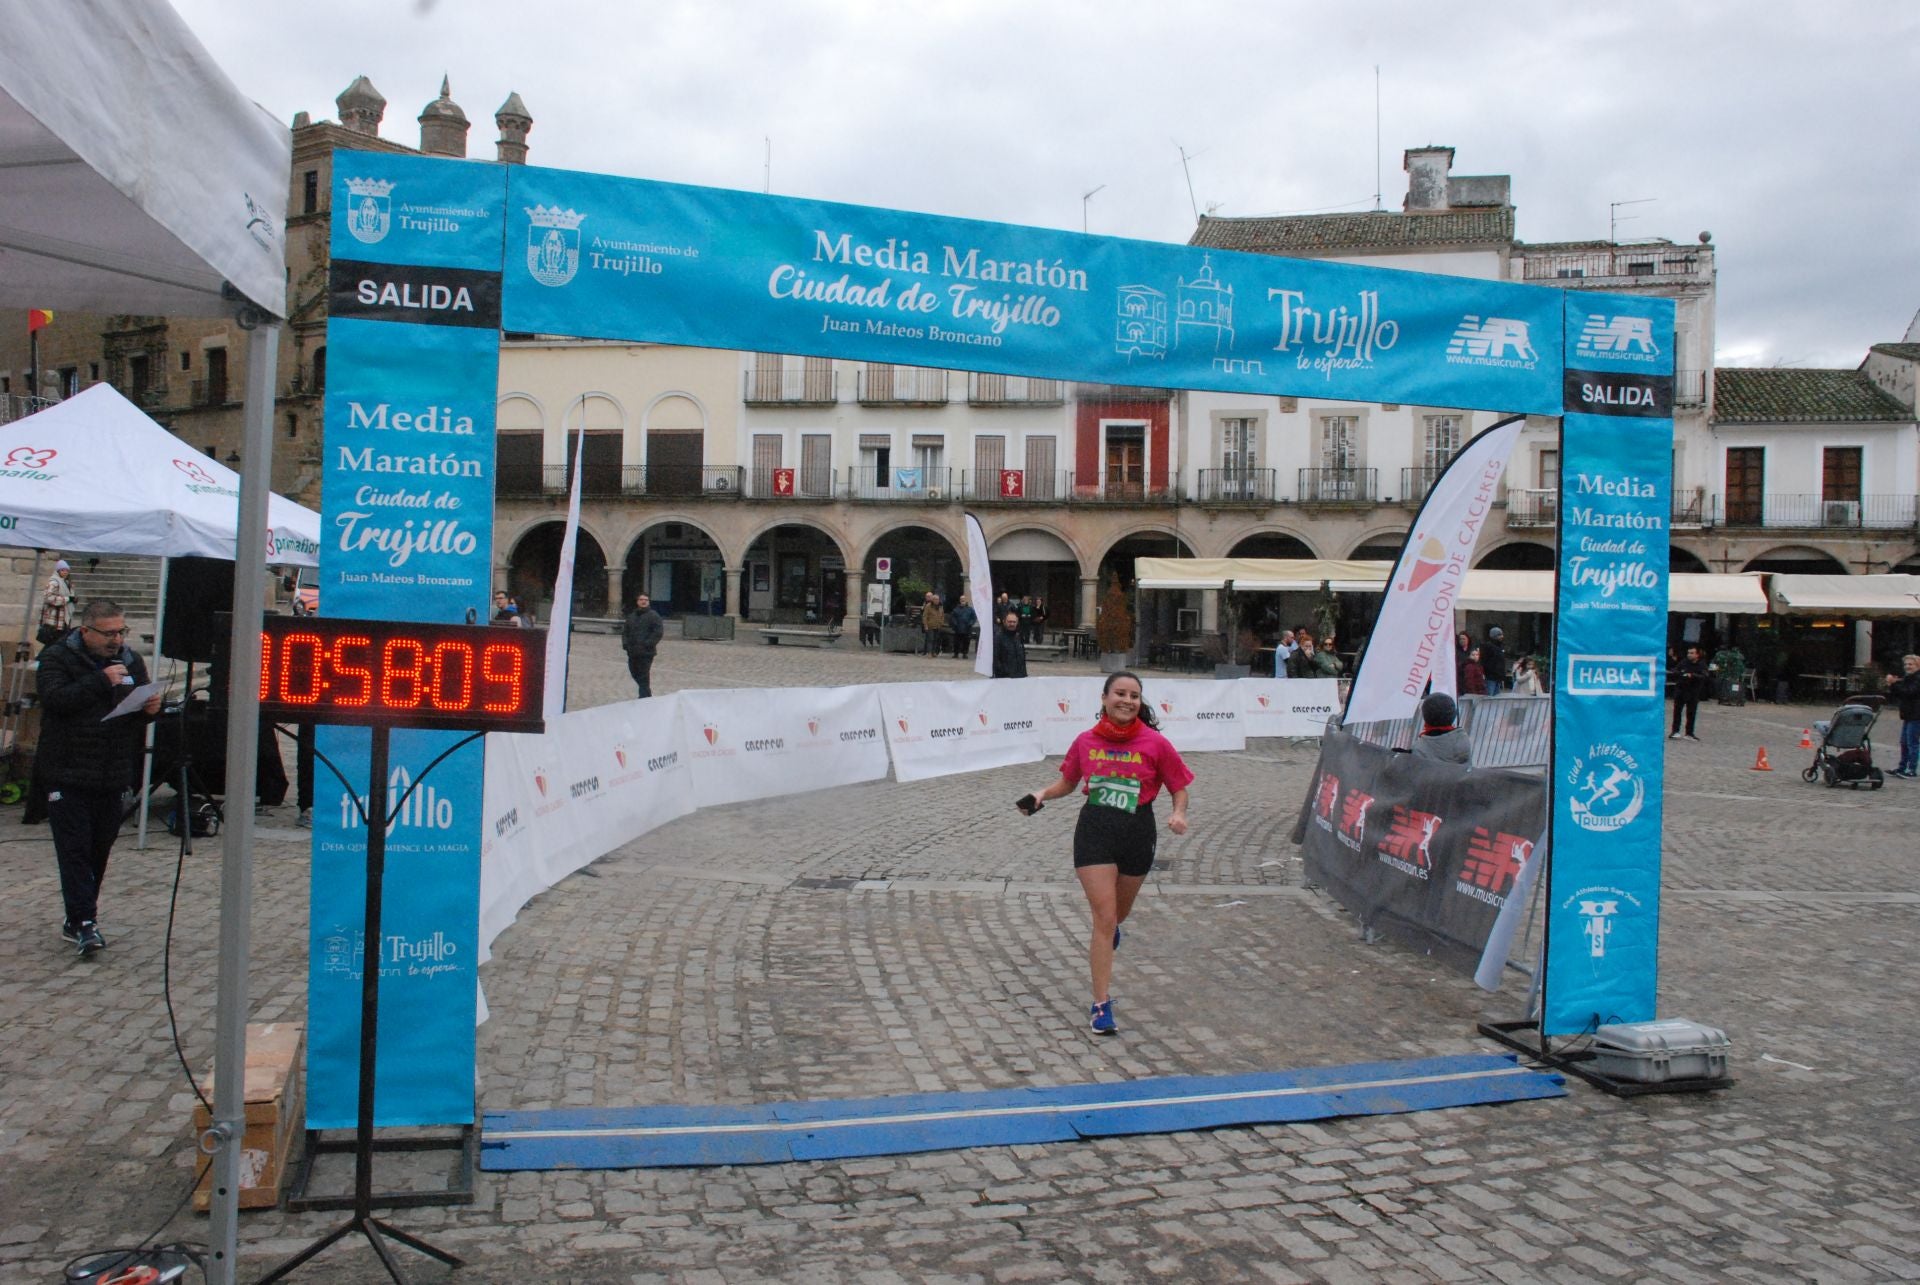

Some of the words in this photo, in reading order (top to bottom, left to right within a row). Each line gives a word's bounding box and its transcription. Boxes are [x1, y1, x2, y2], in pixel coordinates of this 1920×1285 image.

[400, 203, 473, 218] Ayuntamiento
[475, 208, 490, 219] de
[399, 214, 459, 235] Trujillo
[592, 236, 680, 256] Ayuntamiento
[683, 246, 699, 258] de
[590, 252, 663, 277] Trujillo
[813, 229, 930, 275] Media
[941, 245, 1089, 292] Maratón
[356, 278, 474, 313] SALIDA
[768, 264, 892, 310] Ciudad
[896, 281, 940, 313] de
[948, 284, 1061, 333] Trujillo
[820, 314, 860, 334] Juan
[865, 318, 924, 340] Mateos
[928, 326, 1003, 348] Broncano
[1268, 287, 1399, 362] Trujillo
[1296, 347, 1311, 370] te
[1446, 354, 1536, 370] www.musicrun.es
[1582, 383, 1656, 407] SALIDA
[347, 401, 476, 435] Media
[337, 446, 483, 478] Maratón
[355, 485, 431, 509] Ciudad
[434, 491, 463, 510] de
[1577, 473, 1656, 498] Media
[1571, 506, 1663, 531] Maratón
[335, 511, 477, 568] Trujillo
[1580, 536, 1627, 555] Ciudad
[1628, 540, 1647, 555] de
[1447, 553, 1466, 577] DE
[1568, 555, 1659, 598] Trujillo
[340, 571, 368, 584] Juan
[371, 572, 414, 585] Mateos
[417, 574, 473, 586] Broncano
[1591, 600, 1620, 611] Mateos
[1579, 667, 1642, 685] HABLA
[1567, 756, 1584, 785] Club
[1588, 743, 1638, 770] Atletismo
[1098, 787, 1128, 809] 240
[438, 843, 470, 852] MAGIA
[386, 931, 457, 963] Trujillo
[408, 962, 419, 976] te
